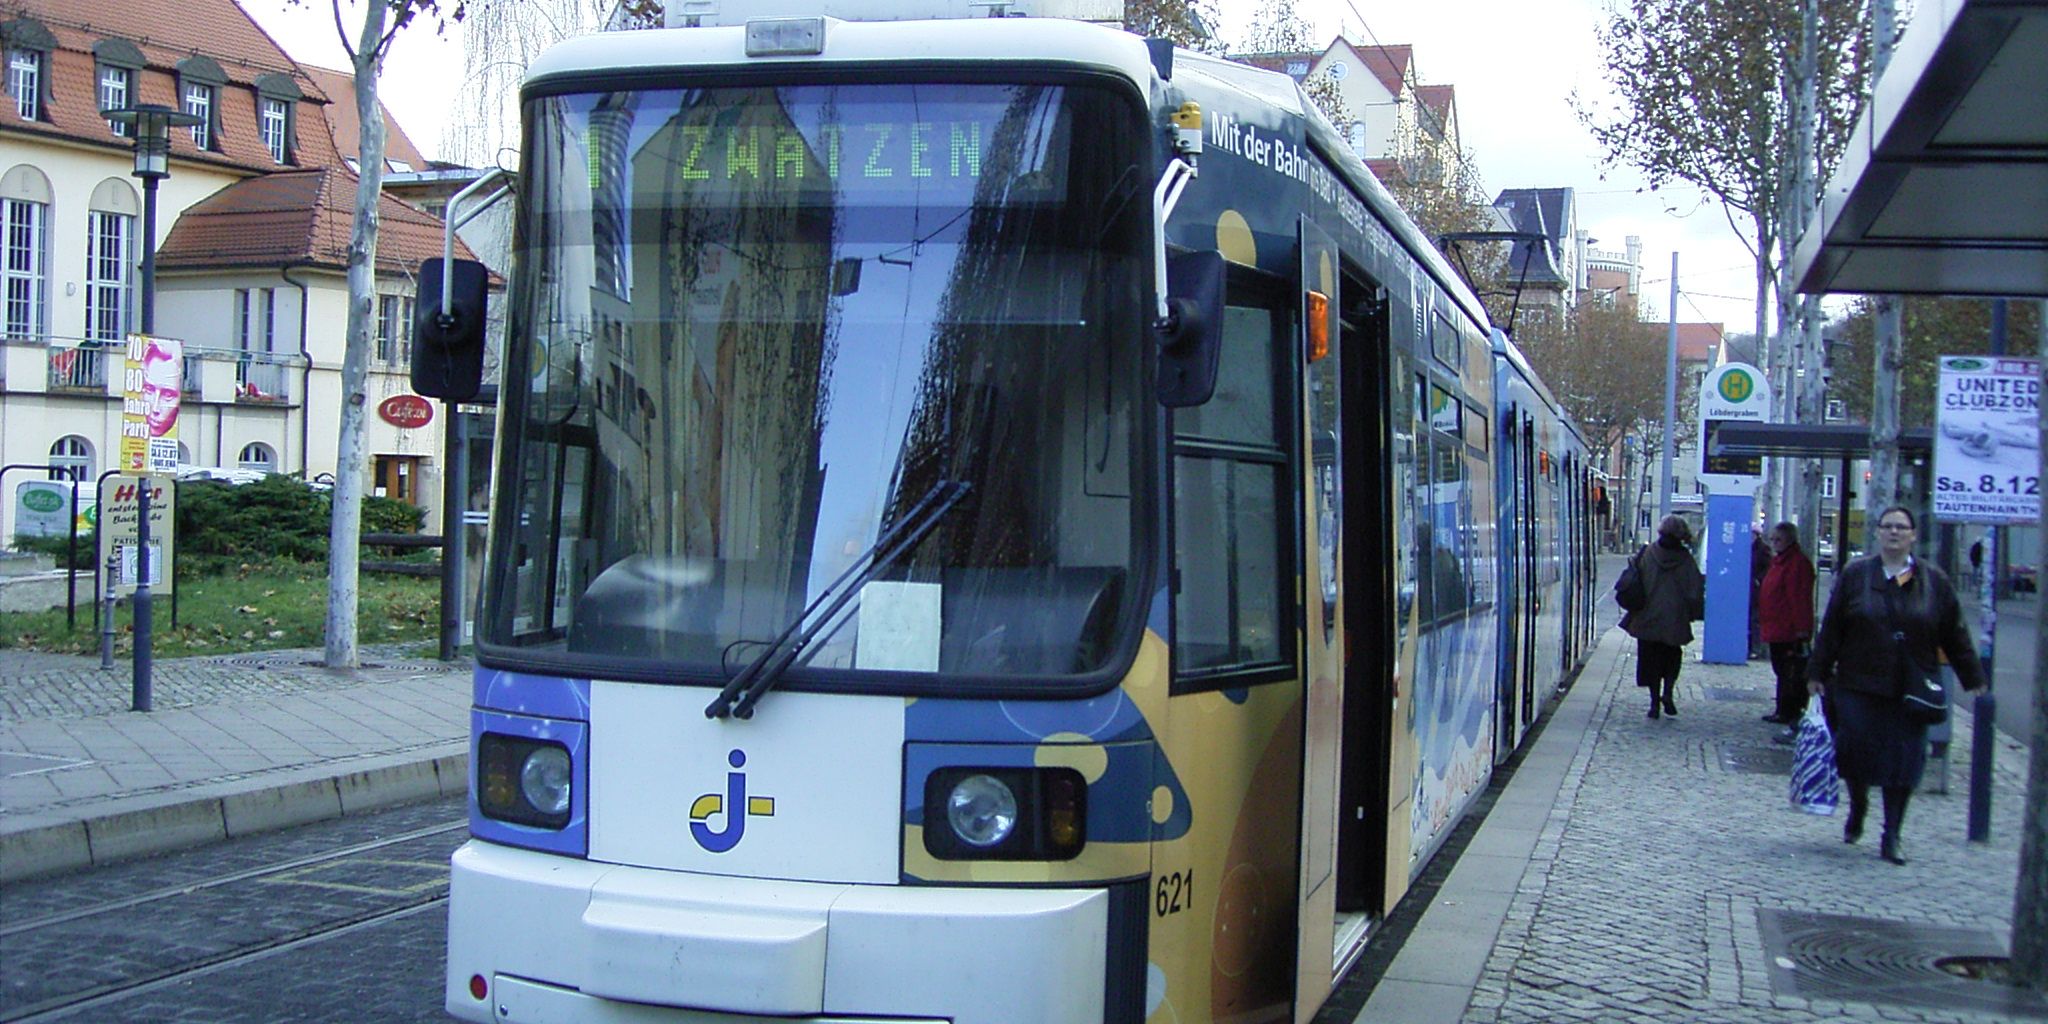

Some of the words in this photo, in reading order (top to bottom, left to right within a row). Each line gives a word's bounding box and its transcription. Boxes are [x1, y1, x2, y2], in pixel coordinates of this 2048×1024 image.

[1211, 111, 1241, 156] Mit
[1244, 125, 1271, 167] der
[1275, 139, 1310, 185] Bahn
[1957, 378, 2039, 395] UNITED
[123, 419, 150, 440] Party
[1937, 476, 1972, 492] Sa.
[1936, 502, 2018, 514] TAUTENHAIN
[1156, 868, 1193, 918] 621
